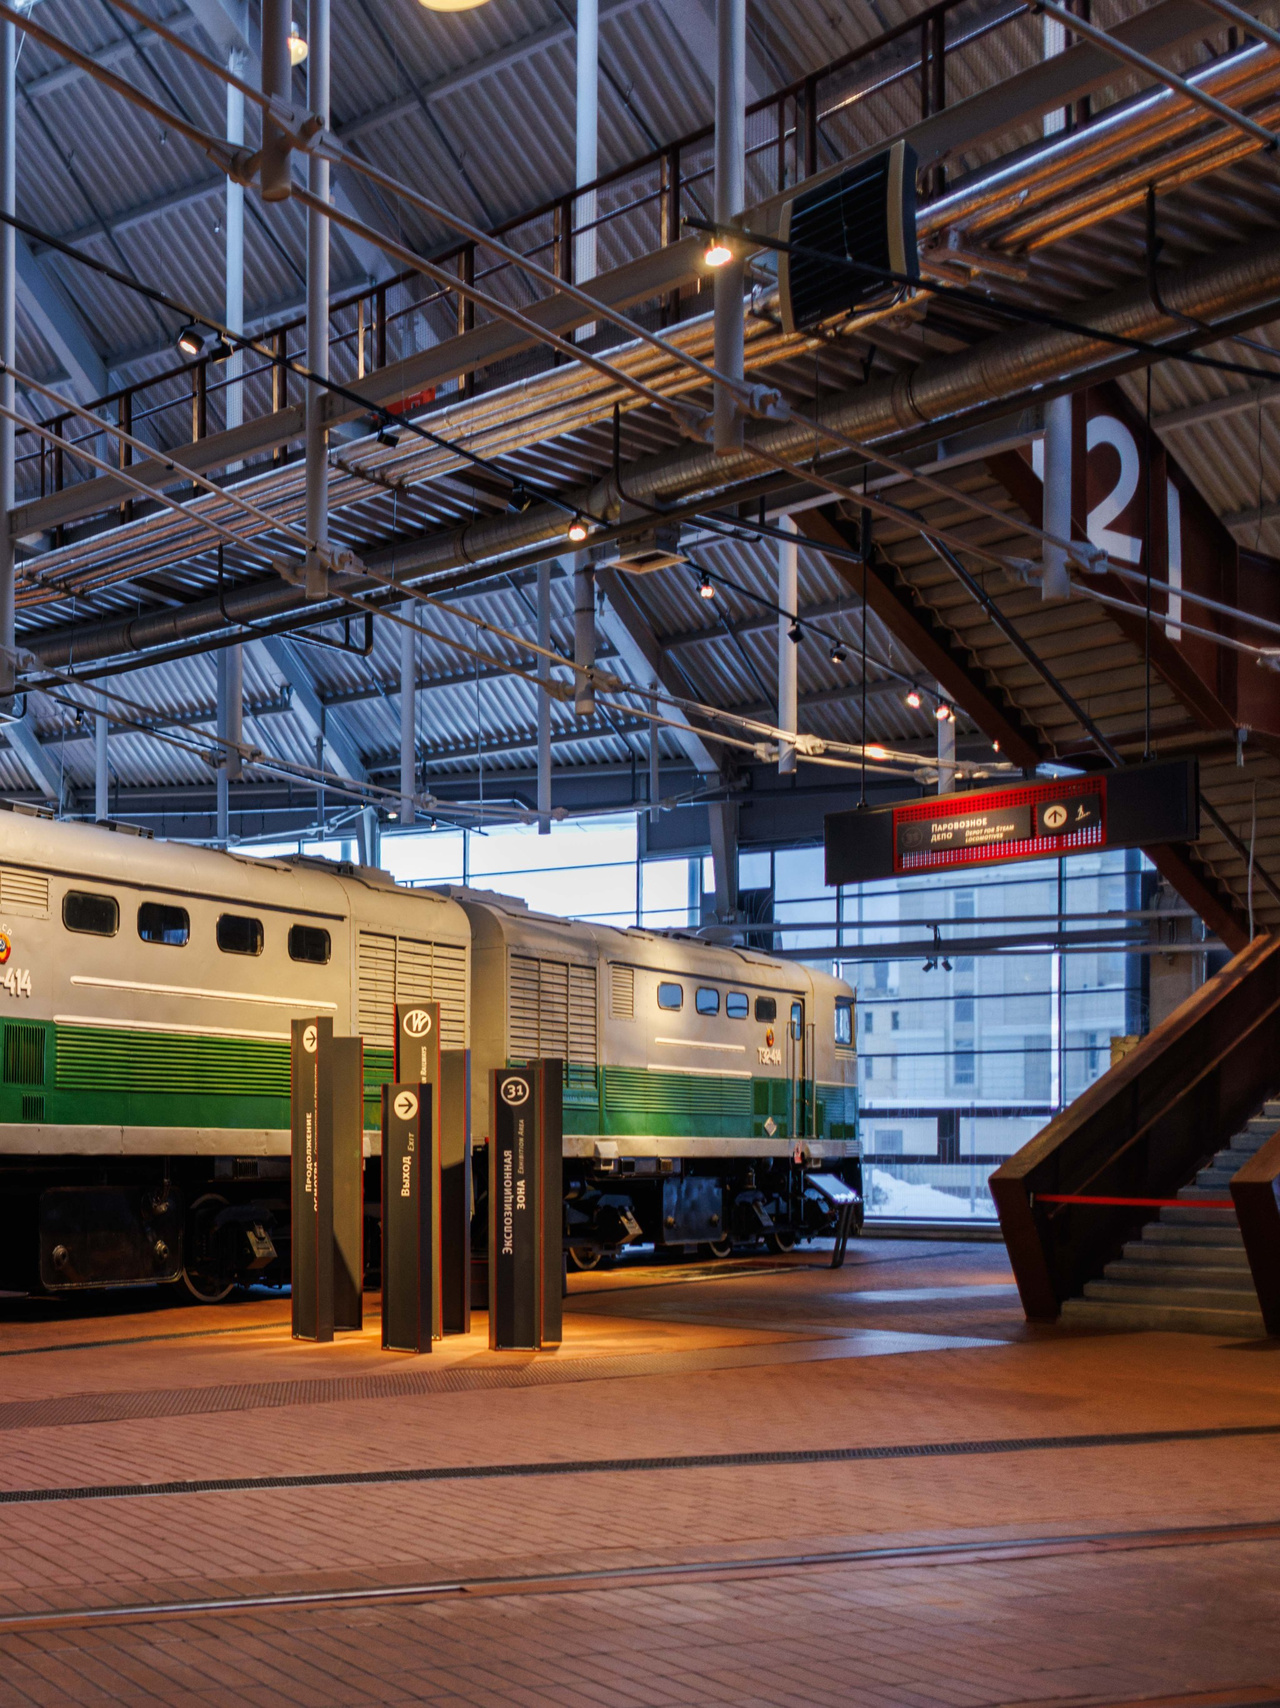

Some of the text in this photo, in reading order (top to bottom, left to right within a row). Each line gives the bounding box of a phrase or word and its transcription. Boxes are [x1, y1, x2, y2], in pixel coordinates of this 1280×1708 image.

[931, 817, 988, 833] ПАРОВОЗНОЕ
[931, 831, 953, 843] ДЕПО
[506, 1084, 524, 1099] 31
[407, 1131, 415, 1152] EXIT
[400, 1155, 412, 1197] ВЫХОД
[502, 1149, 514, 1255] ЭКСПОЗИЦИОННАЯ
[516, 1179, 526, 1210] ЗОНА
